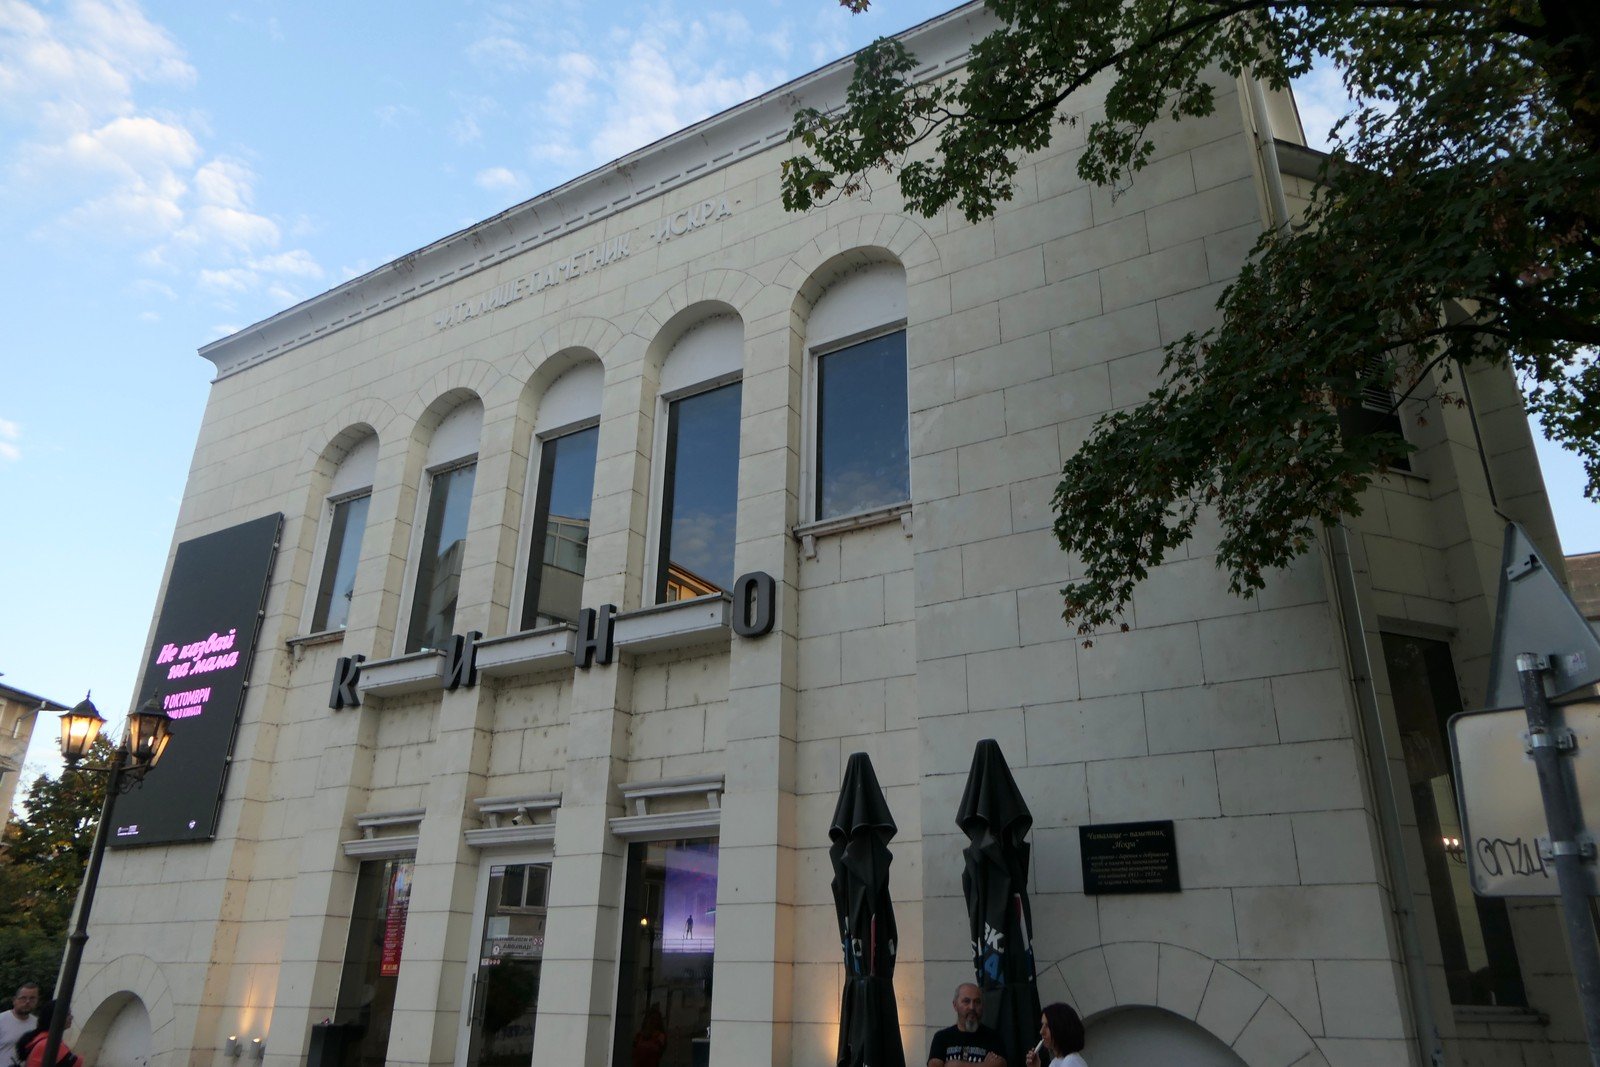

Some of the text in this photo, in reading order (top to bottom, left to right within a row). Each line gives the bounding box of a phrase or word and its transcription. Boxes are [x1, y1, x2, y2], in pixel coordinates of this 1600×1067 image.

[156, 628, 237, 664] Не казвай
[329, 571, 776, 710] КИНО
[167, 650, 240, 680] на мама
[163, 687, 211, 710] 9 ОКТОМВРИ
